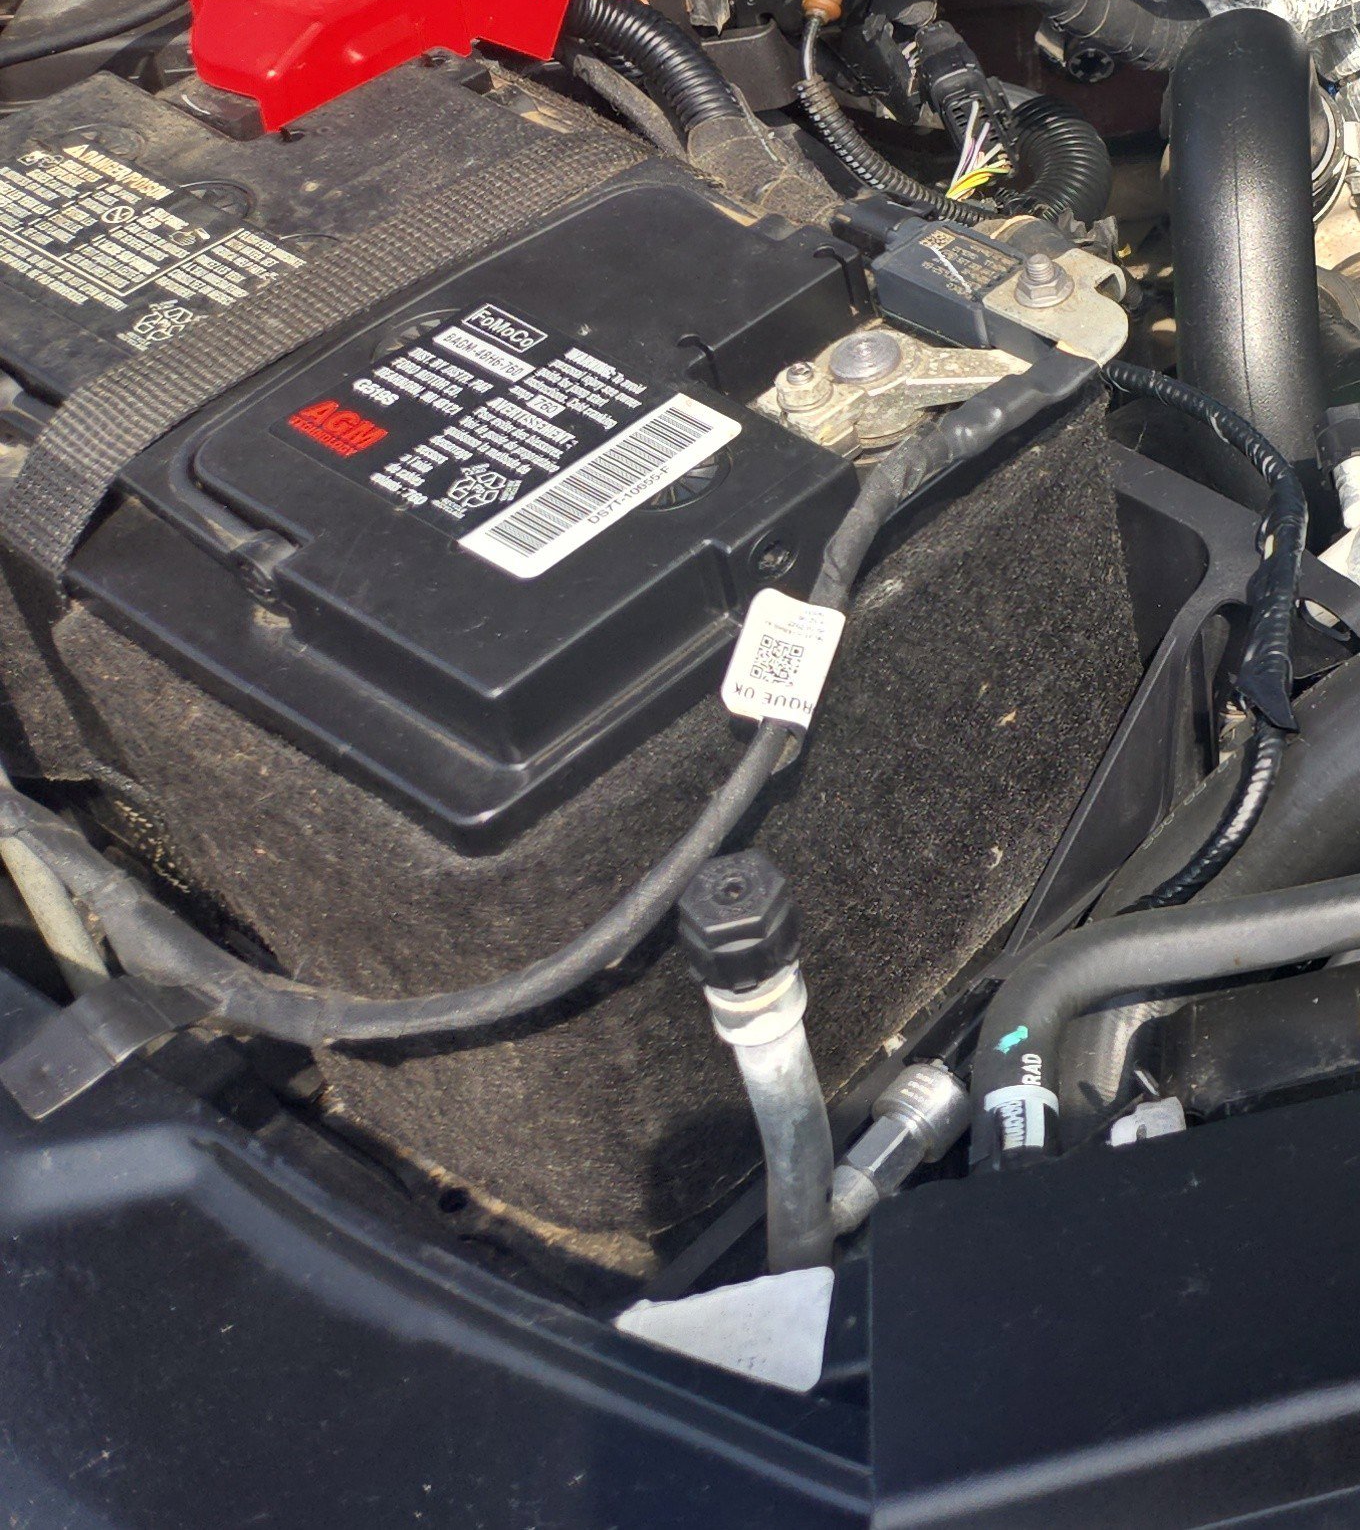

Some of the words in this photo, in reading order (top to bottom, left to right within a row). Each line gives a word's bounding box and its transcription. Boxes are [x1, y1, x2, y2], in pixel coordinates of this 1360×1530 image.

[75, 148, 175, 202] DANGER/POISON
[466, 309, 544, 348] FoMoCo
[367, 365, 431, 397] DEARBORN,
[390, 357, 423, 374] FORD
[412, 368, 453, 389] MOTOR
[350, 378, 399, 408] G519S
[531, 398, 561, 414] 760
[297, 398, 391, 450] AGM
[575, 406, 622, 430] cranking
[288, 415, 358, 459] TECHNOLOGY
[399, 488, 431, 506] 760
[1021, 1053, 1043, 1086] RAD
